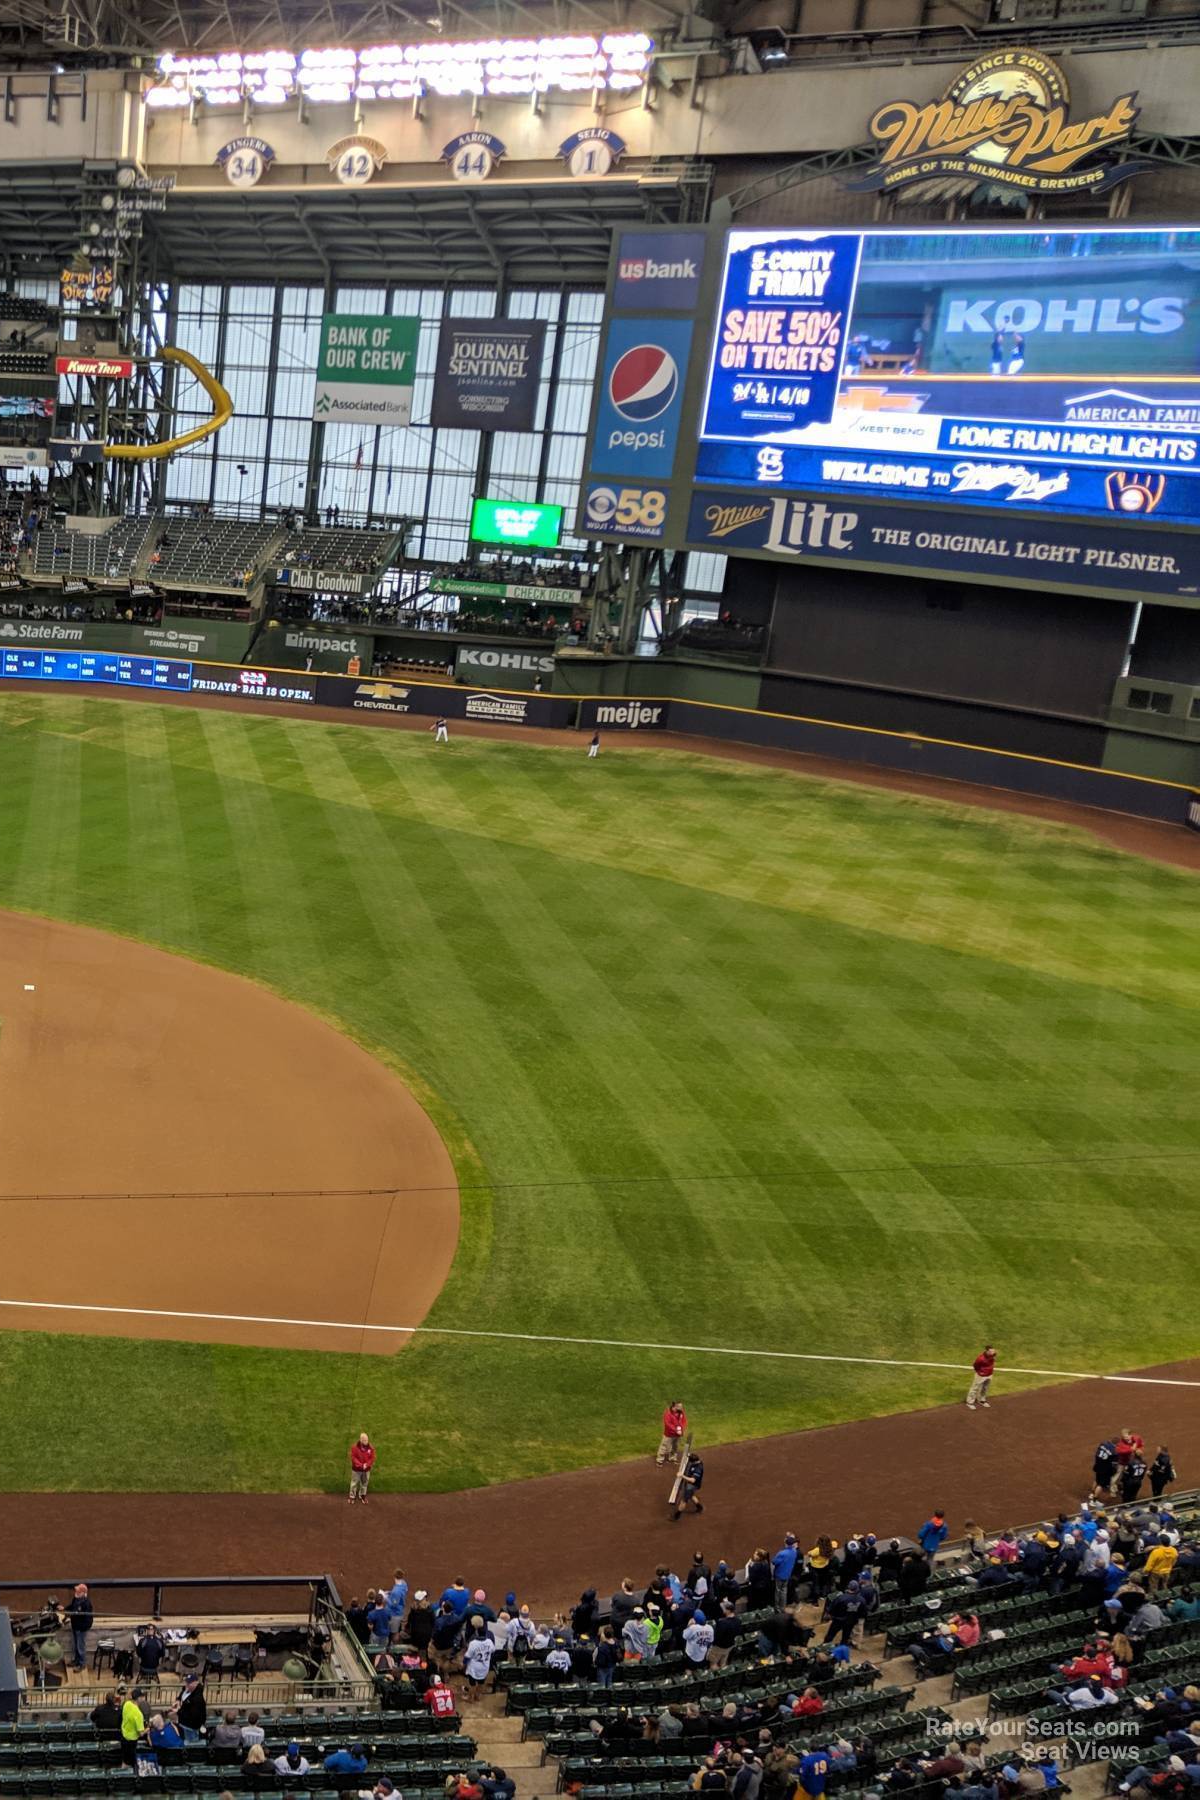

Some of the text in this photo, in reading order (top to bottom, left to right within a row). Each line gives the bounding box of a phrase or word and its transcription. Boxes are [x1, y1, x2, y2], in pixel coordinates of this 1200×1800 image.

[966, 54, 1049, 81] SINCE 2001
[458, 132, 492, 145] AARON
[578, 129, 609, 141] SELIG
[871, 95, 1136, 172] Miller Park
[227, 137, 266, 153] FINGERS
[232, 157, 256, 179] 34
[342, 155, 369, 177] 42
[458, 153, 485, 175] 44
[585, 150, 596, 174] 1
[885, 161, 1105, 188] HOME OF THE MILWAUKEE BREWERS
[748, 270, 831, 296] FRIDAY
[946, 296, 1186, 334] KOHL'S
[328, 326, 390, 346] BANK OF
[723, 310, 841, 346] SAVE 50%
[326, 350, 405, 371] OUR CREW
[451, 342, 529, 360] JOURNAL
[721, 344, 836, 372] ON TICKETS
[448, 360, 527, 378] SENTINEL
[1066, 407, 1150, 421] AMERICAN
[609, 429, 663, 451] pepsi
[859, 425, 891, 434] WEST
[950, 427, 1197, 461] HOME RUN HIGHLIGHTS
[822, 460, 929, 488] WELCOME
[933, 472, 951, 487] TO
[615, 489, 667, 527] 58
[615, 524, 662, 536] MILWAUKEE
[705, 497, 1181, 574] Miller Lite THE ORIGINAL LIGHT PILSNER.
[290, 572, 362, 593] Club Goodwill
[514, 587, 545, 600] CHECK
[550, 589, 575, 602] DECK
[150, 641, 179, 649] STREAMING
[300, 633, 357, 653] impact
[459, 650, 555, 672] KOHL'S
[243, 685, 264, 695] BAR
[266, 688, 277, 696] IS
[280, 689, 313, 700] OPEN.
[353, 700, 409, 712] CHEVROLET
[467, 700, 500, 708] AMERICAN
[597, 702, 662, 728] meijer
[437, 1697, 453, 1711] 24
[814, 1760, 827, 1775] 19
